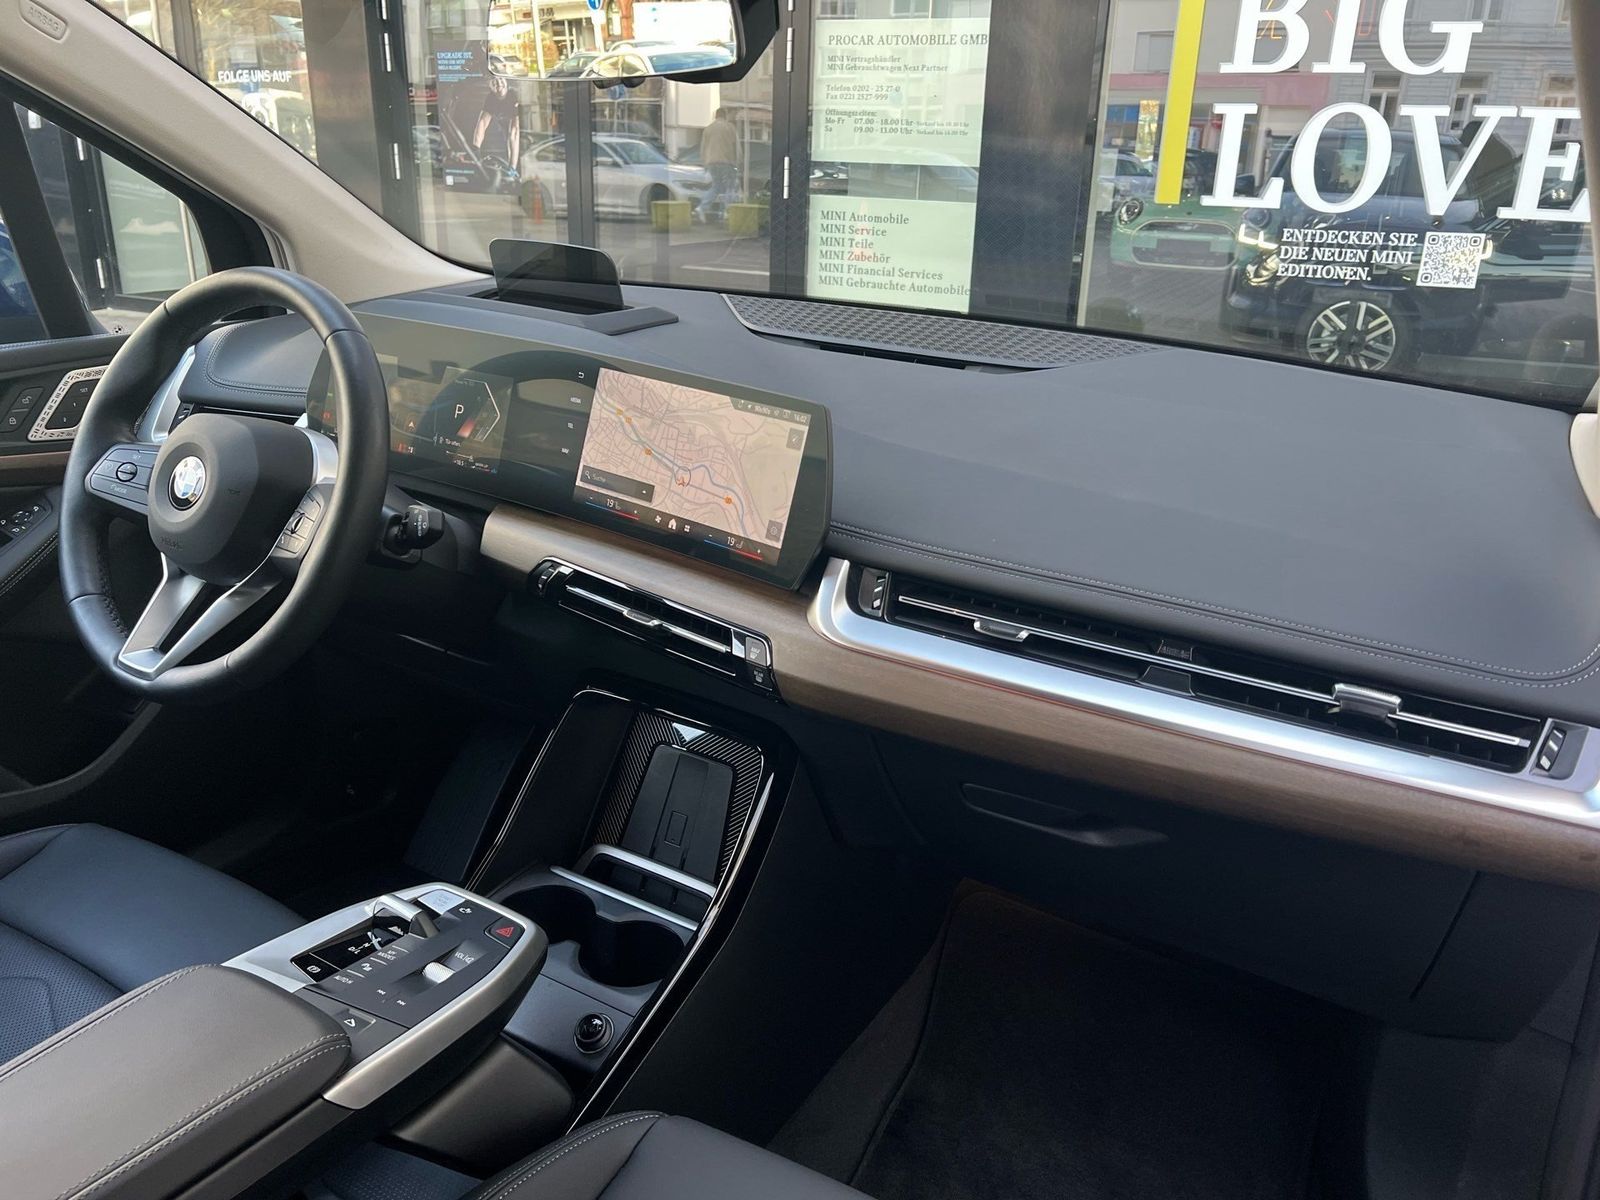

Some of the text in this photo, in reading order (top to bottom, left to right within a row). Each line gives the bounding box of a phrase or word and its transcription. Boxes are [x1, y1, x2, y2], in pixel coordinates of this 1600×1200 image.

[828, 35, 874, 46] PROCAR
[877, 34, 957, 46] AUTOMOBILE
[1219, 0, 1484, 75] BIG
[846, 55, 901, 64] Vertragshändler
[827, 63, 844, 71] MINI
[845, 63, 902, 72] Gebrauchtwagen
[217, 70, 292, 82] FOLGE UNS AUF
[824, 125, 833, 133] Sa
[900, 127, 913, 135] Uhr
[900, 119, 913, 127] Uhr
[1200, 102, 1591, 222] LOVE
[820, 210, 909, 224] MINI Automobile
[820, 223, 887, 237] MINI Service
[1281, 228, 1418, 246] ENTDECKEN SIE
[820, 236, 874, 249] MINI Teile
[819, 250, 891, 264] MINI Zubehör
[1279, 246, 1415, 265] DIE NEUEN MINI
[819, 263, 943, 280] MINI Financial Services
[1276, 263, 1372, 281] EDITIONEN.
[818, 275, 971, 296] MINI Gebrauchte Automobile
[454, 404, 464, 419] P
